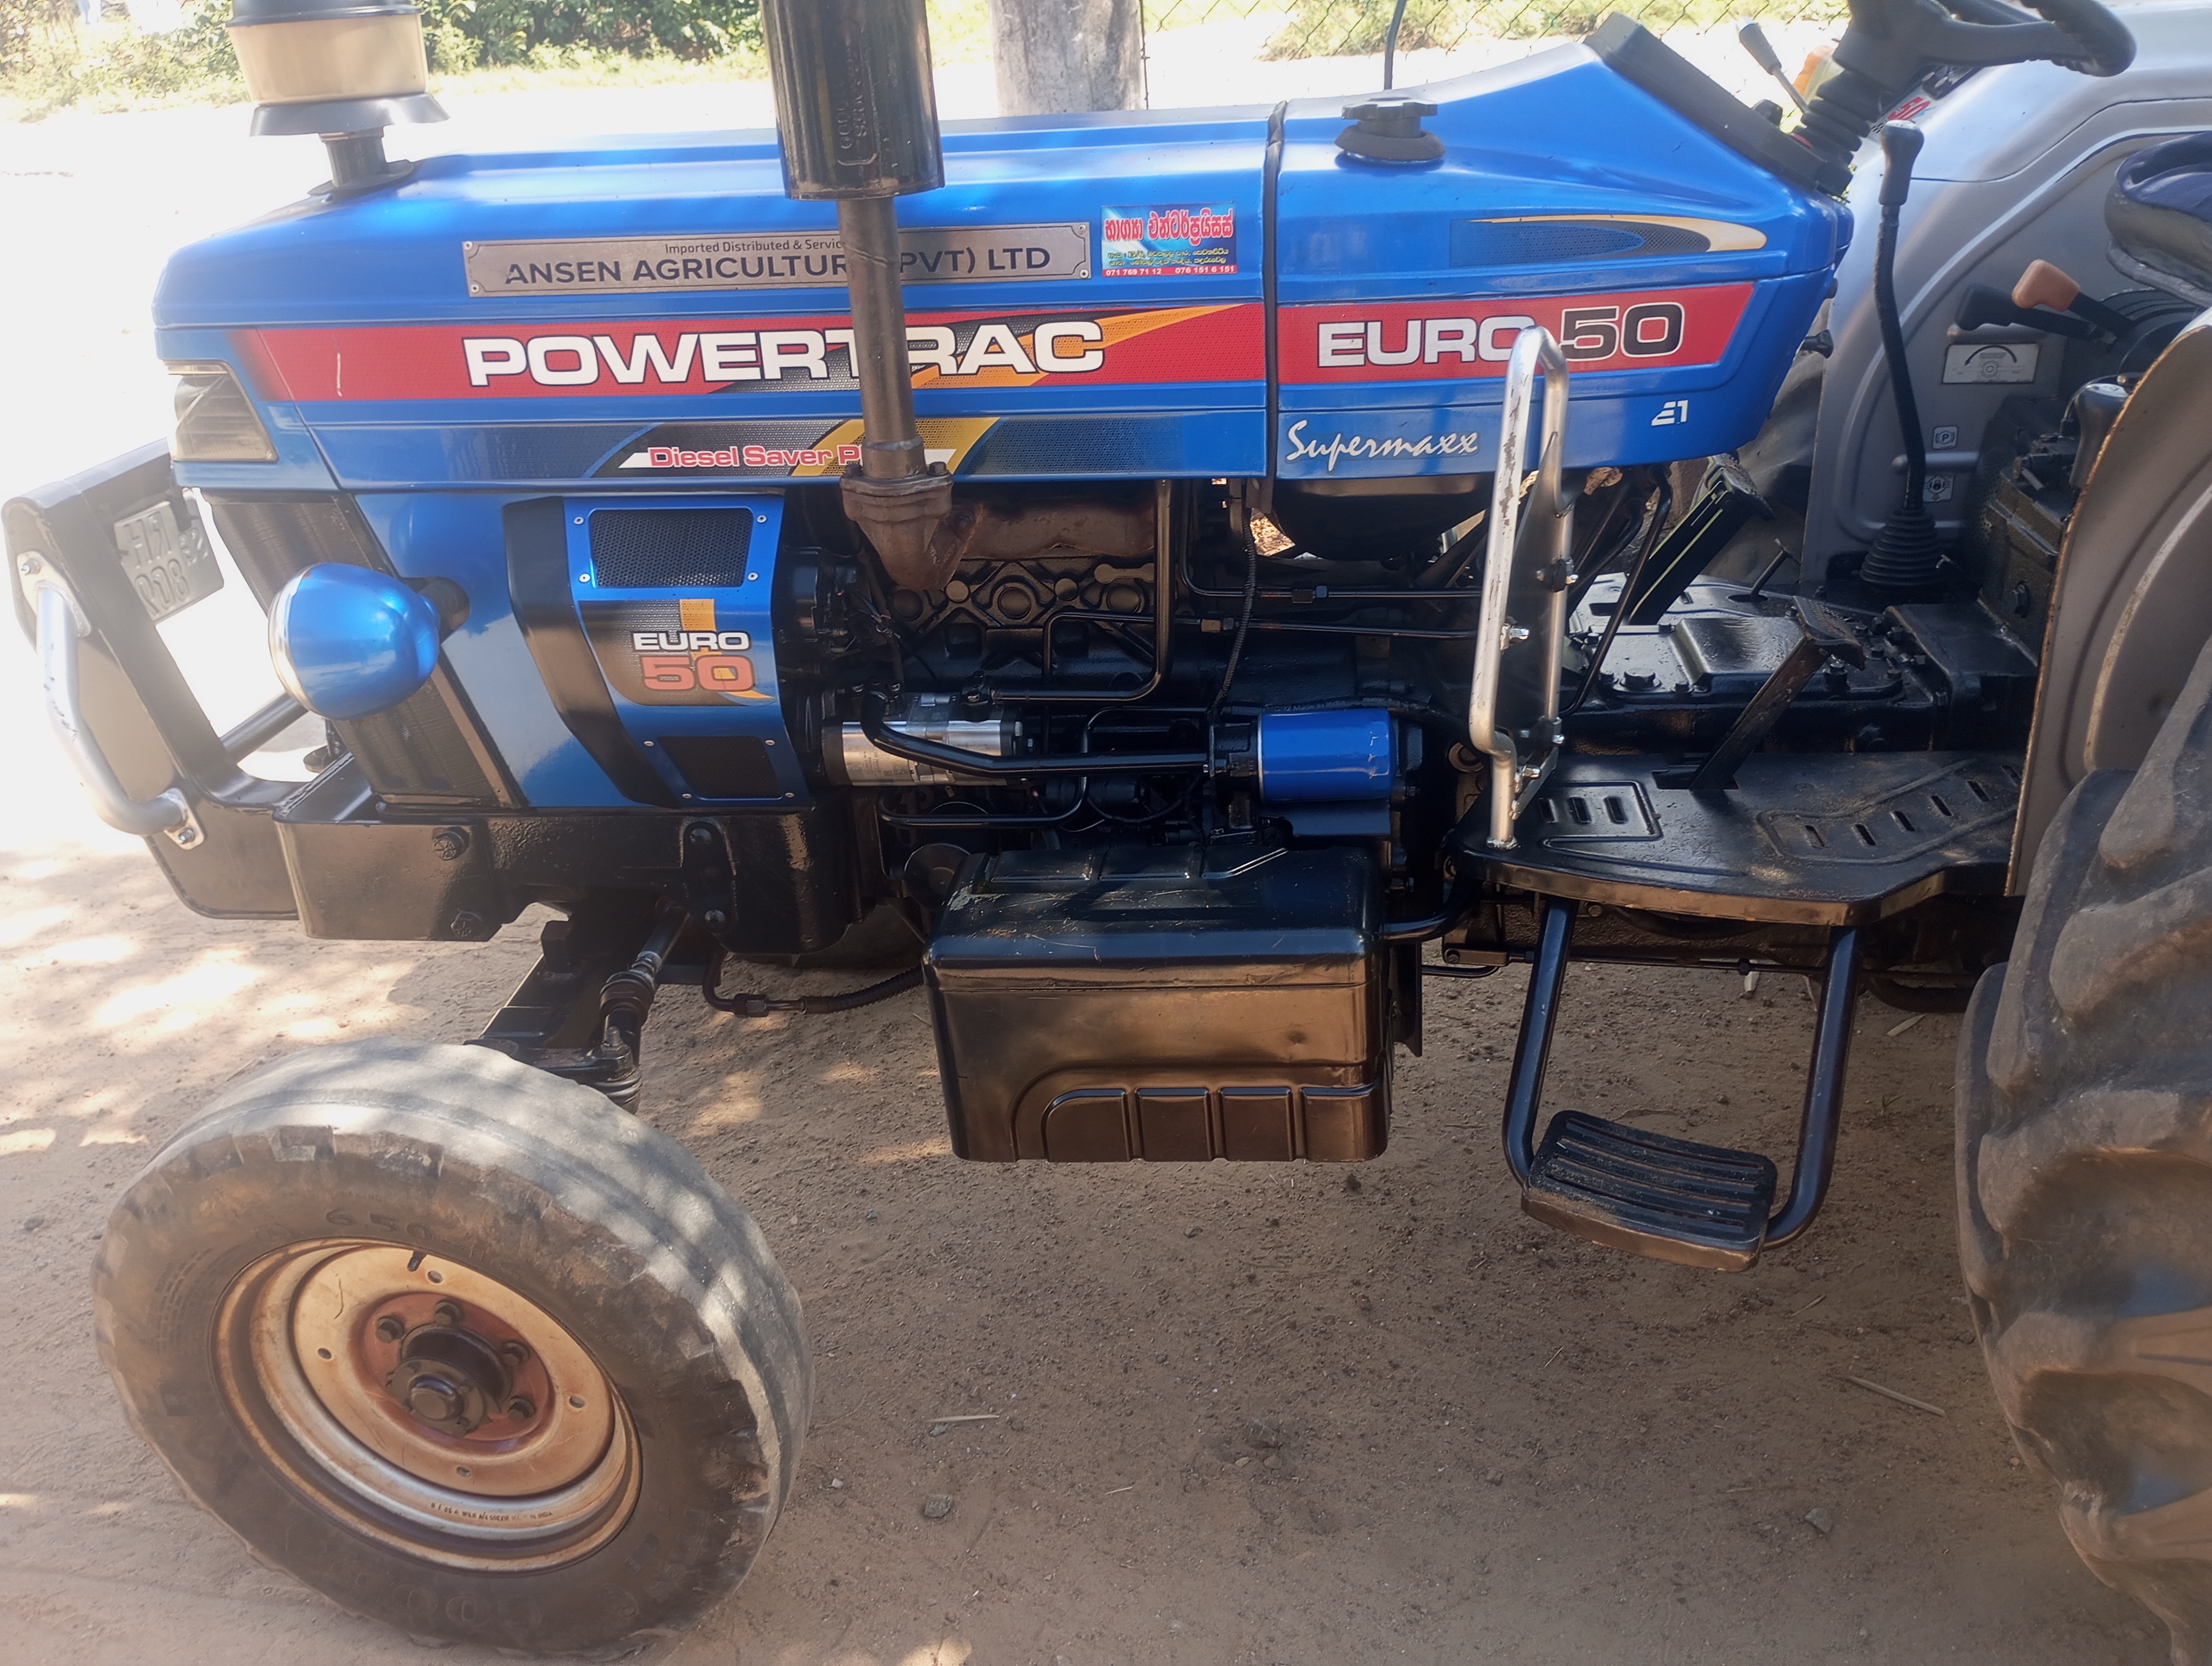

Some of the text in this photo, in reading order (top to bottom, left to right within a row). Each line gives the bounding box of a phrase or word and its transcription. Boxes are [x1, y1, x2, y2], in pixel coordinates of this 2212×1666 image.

[1887, 97, 1931, 120] 50
[665, 238, 841, 255] Imported Distributed & Servic
[505, 247, 1051, 285] ANSEN AGRICULTUR PVT) LTD
[1317, 302, 1685, 367] EURO 50
[462, 321, 1104, 388] POWERTRAC
[647, 445, 863, 467] Diesel Saver P
[1285, 419, 1479, 471] Supermaxx
[632, 630, 751, 651] EURO
[641, 655, 756, 692] 50
